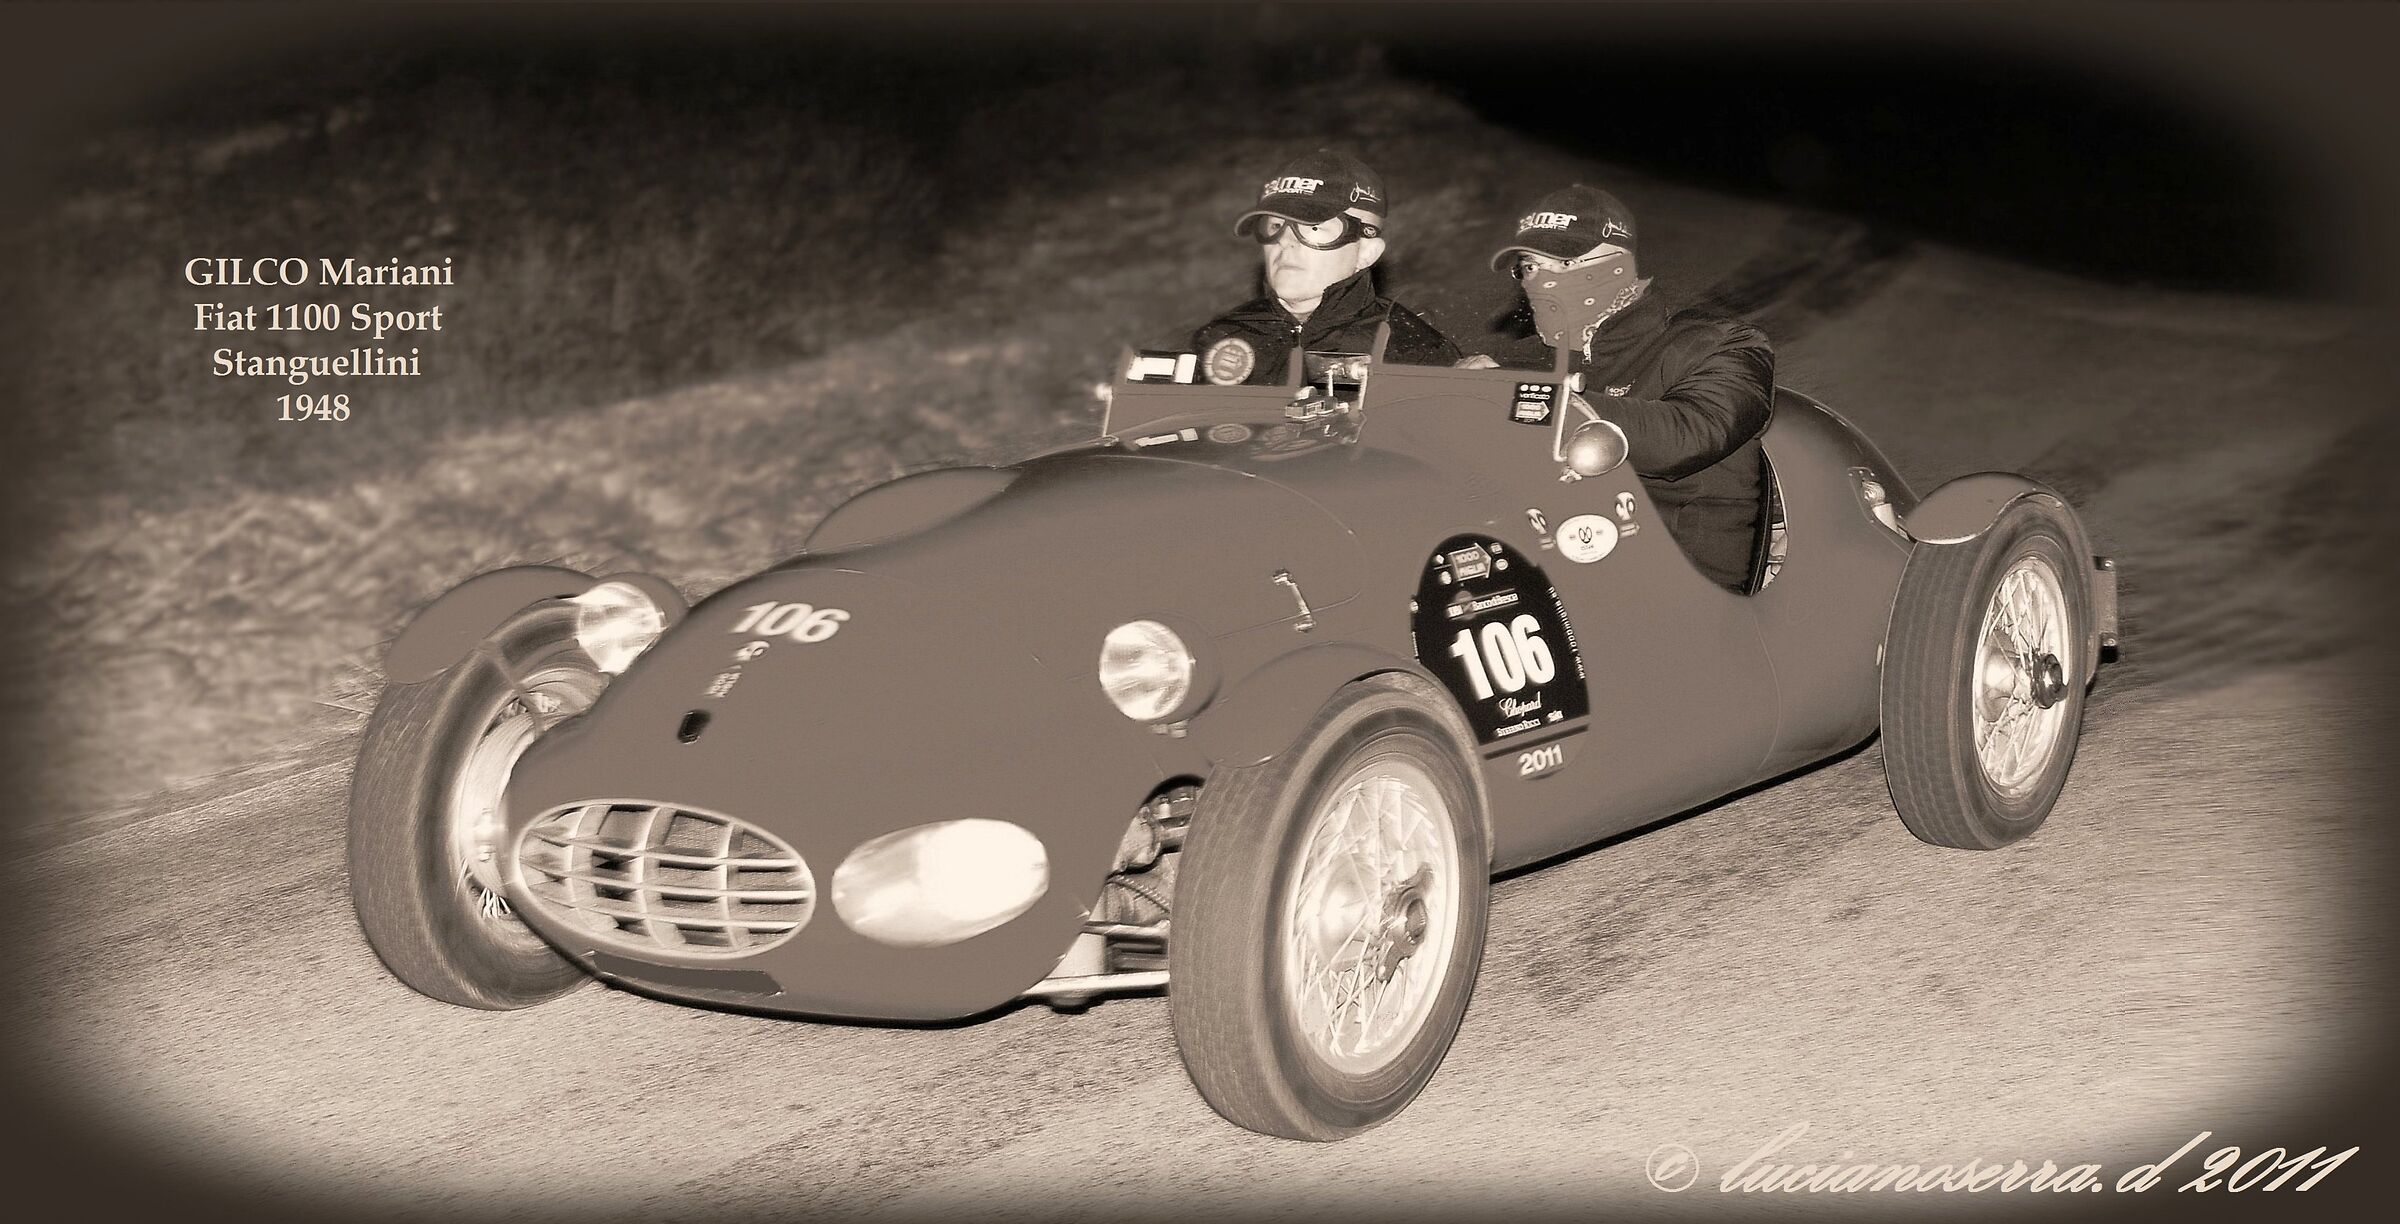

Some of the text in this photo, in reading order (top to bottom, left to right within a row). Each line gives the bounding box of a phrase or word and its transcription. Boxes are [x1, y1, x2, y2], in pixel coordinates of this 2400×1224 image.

[730, 600, 851, 643] 106
[1450, 614, 1556, 700] 106
[1518, 744, 1564, 776] 2011
